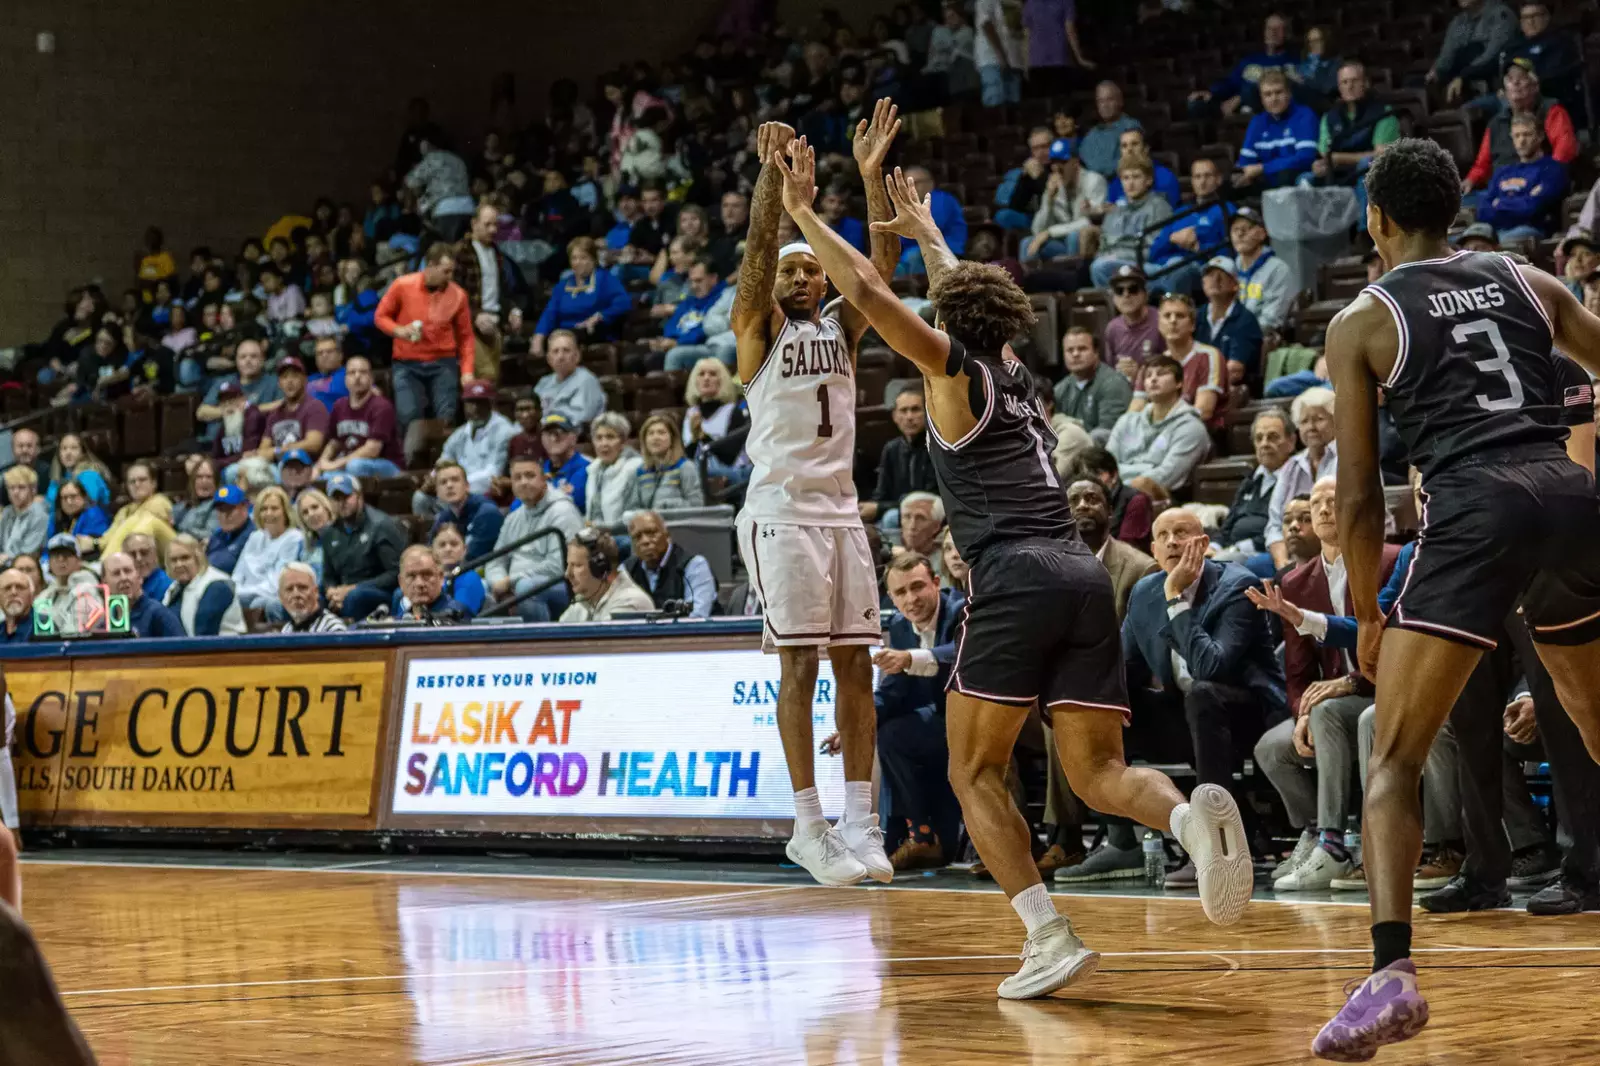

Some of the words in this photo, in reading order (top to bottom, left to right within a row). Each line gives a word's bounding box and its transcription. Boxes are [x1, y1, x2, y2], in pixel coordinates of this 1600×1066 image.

[1427, 283, 1506, 318] JONES
[1451, 318, 1525, 412] 3
[816, 384, 833, 438] 1
[1026, 416, 1060, 488] 1
[416, 674, 485, 688] RESTORE
[492, 673, 534, 687] YOUR
[542, 671, 598, 686] VISION
[11, 690, 105, 759] GE
[127, 684, 363, 759] COURT
[411, 700, 520, 745] LASIK
[527, 698, 582, 746] AT
[63, 765, 137, 792] SOUTH
[141, 766, 236, 792] DAKOTA
[403, 750, 588, 798] SANFORD
[597, 750, 761, 798] HEALTH
